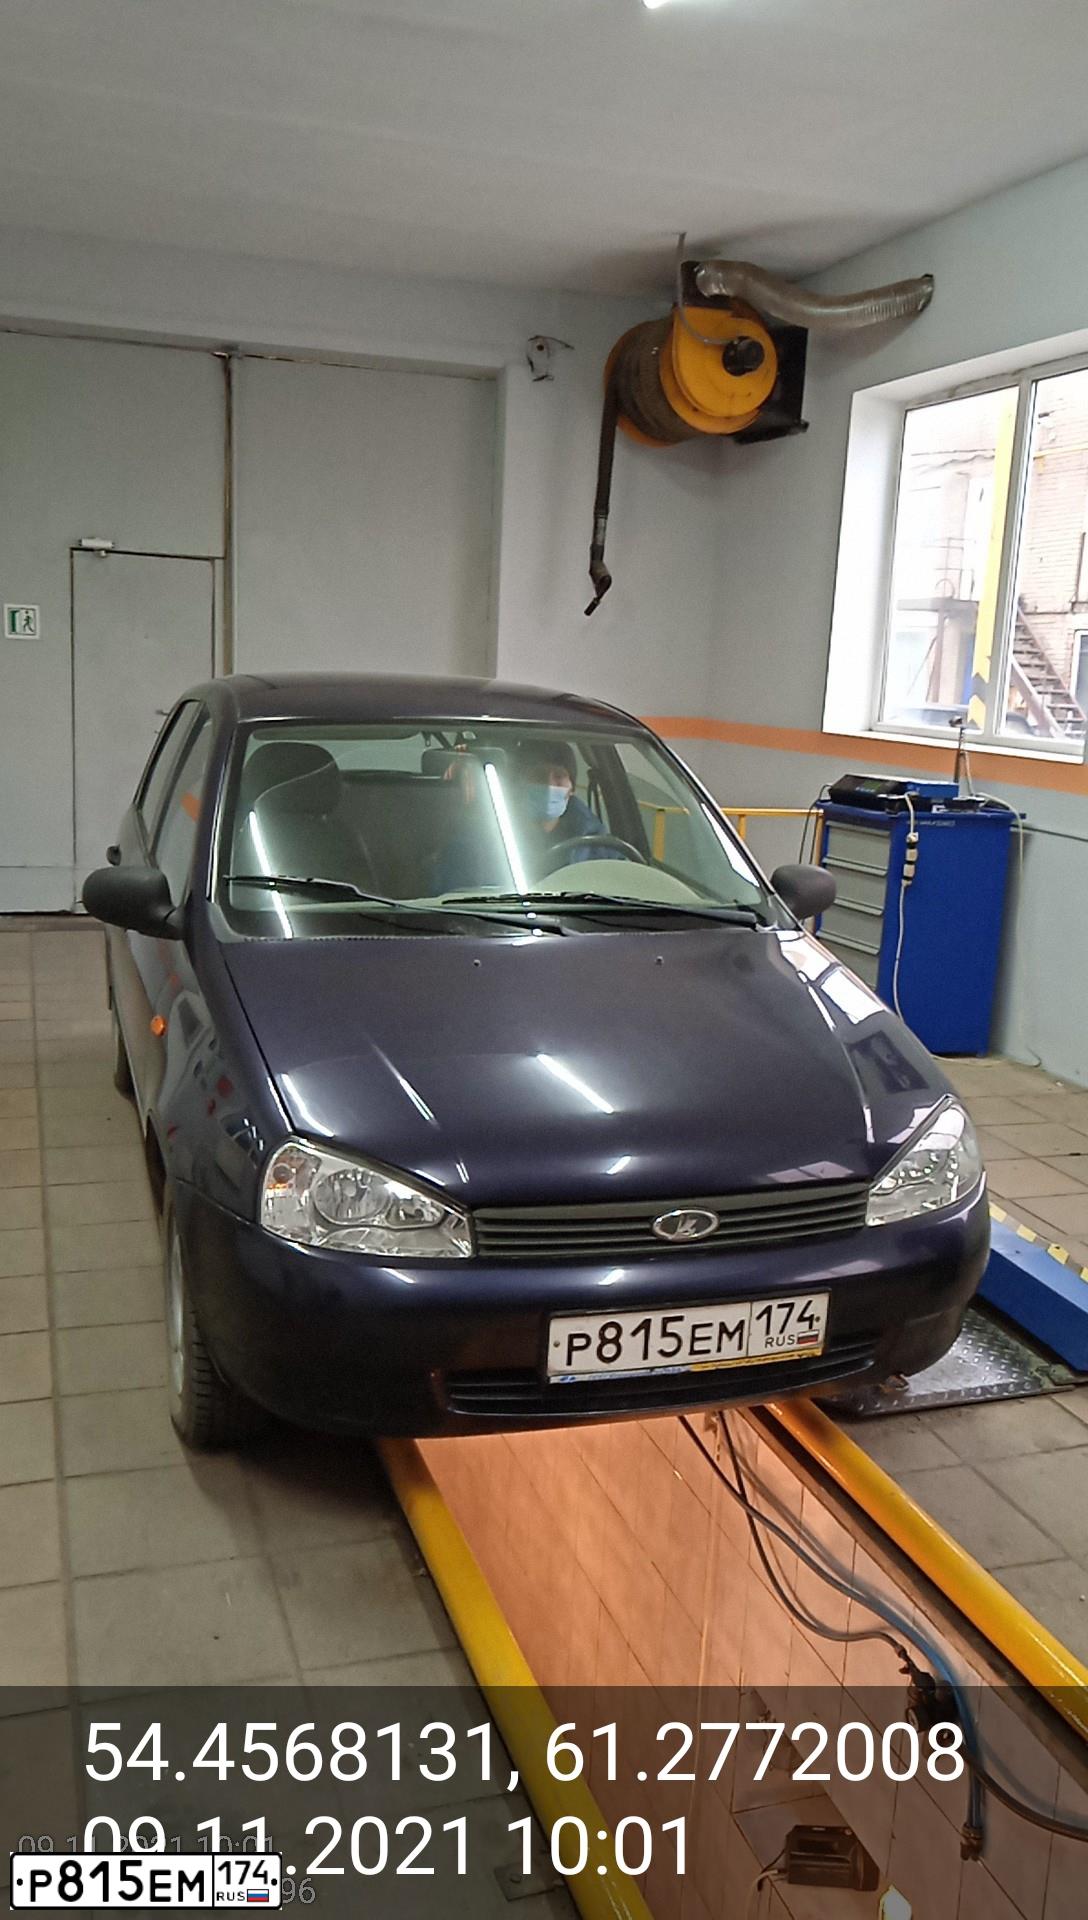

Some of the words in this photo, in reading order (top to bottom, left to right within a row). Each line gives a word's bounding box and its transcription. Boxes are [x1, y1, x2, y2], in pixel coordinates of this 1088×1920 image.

[566, 1315, 746, 1366] Р815ЕМ
[755, 1299, 815, 1336] 174
[764, 1335, 796, 1349] RUS
